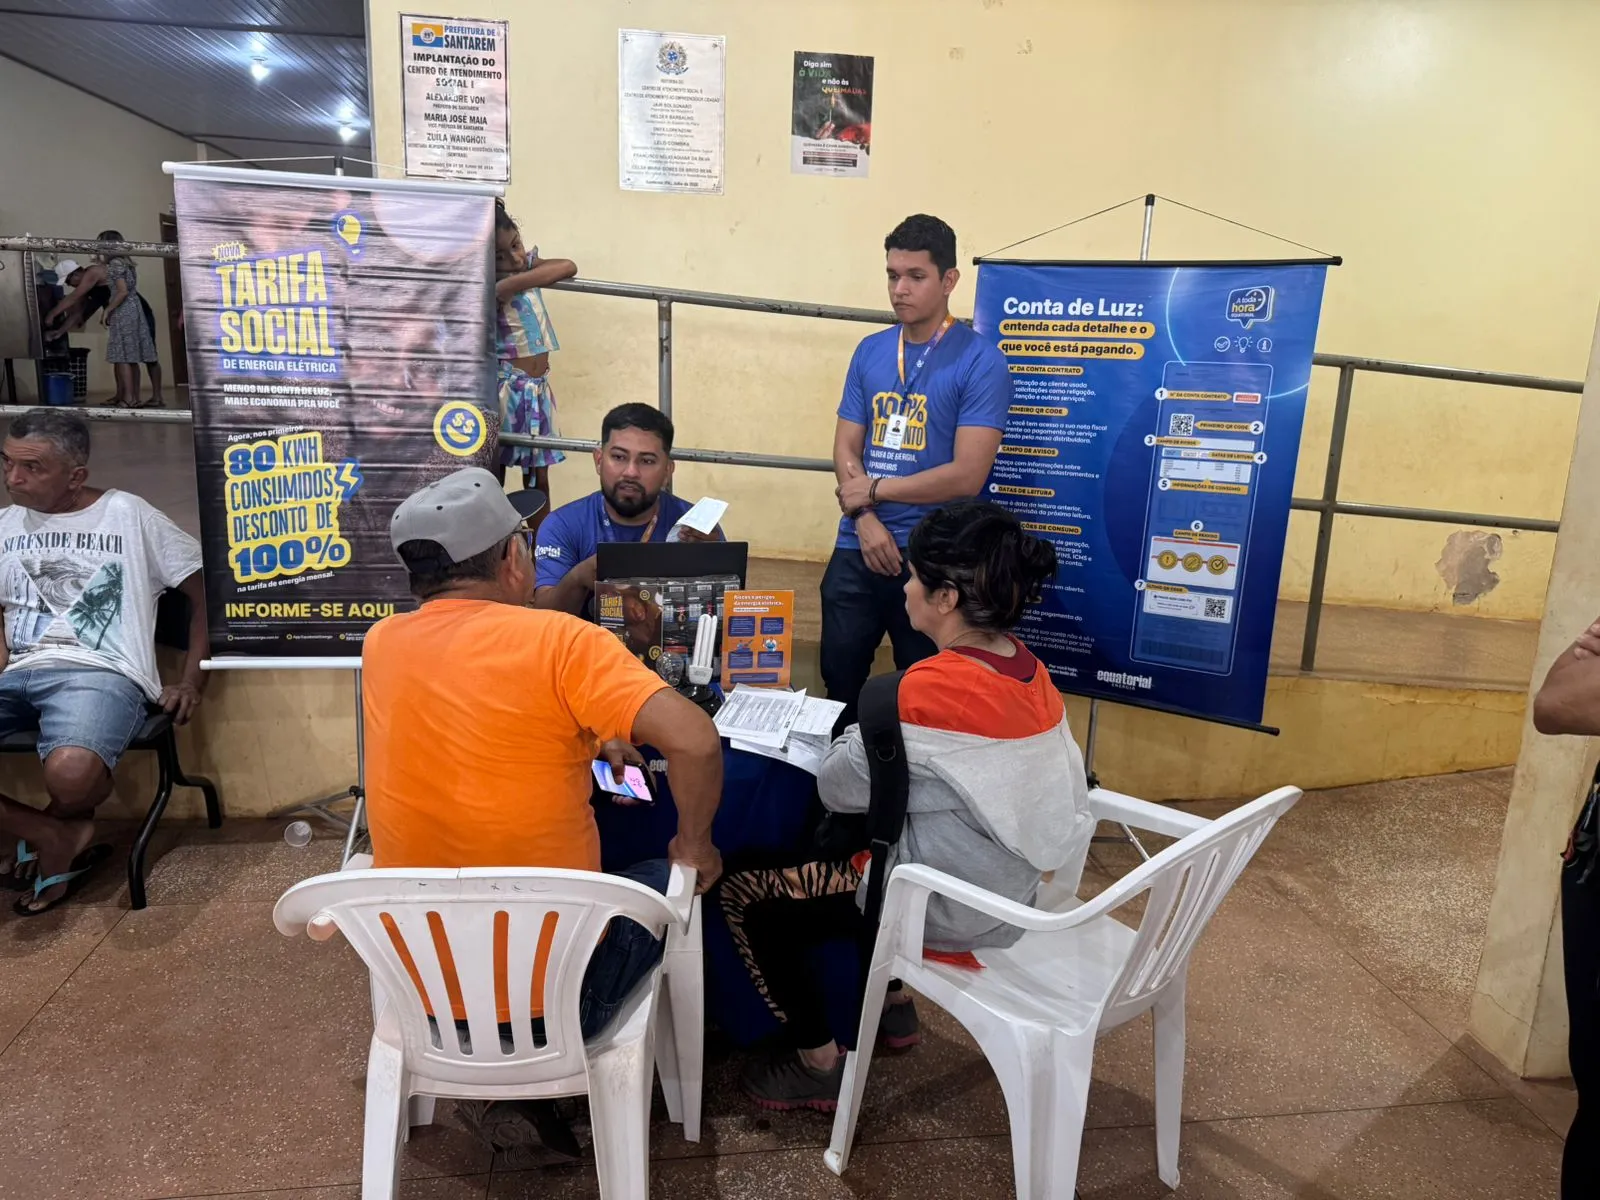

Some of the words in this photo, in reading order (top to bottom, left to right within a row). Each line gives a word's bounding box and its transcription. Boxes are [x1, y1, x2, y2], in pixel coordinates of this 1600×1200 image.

[444, 25, 484, 35] PREFEITURA
[413, 52, 479, 67] IMPLANTAÇÃO
[482, 58, 495, 67] DO
[803, 60, 819, 69] Diga
[407, 65, 436, 75] CENTRO
[438, 67, 448, 76] DE
[450, 68, 502, 80] ATENDIMENTO
[808, 68, 832, 78] VIDA
[470, 95, 485, 105] VON
[424, 113, 447, 122] MARIA
[449, 113, 467, 124] JOSÉ
[469, 116, 488, 125] MAIA
[216, 250, 327, 307] TARIFA
[1003, 297, 1063, 315] Conta
[1068, 298, 1094, 316] de
[1098, 298, 1144, 317] Luz:
[1232, 303, 1255, 312] hora
[219, 307, 335, 356] SOCIAL
[1003, 322, 1049, 331] entenda
[1052, 323, 1079, 332] cada
[1082, 323, 1127, 333] detalhe
[1001, 343, 1022, 353] que
[1024, 342, 1051, 352] você
[1054, 343, 1078, 353] está
[1081, 345, 1137, 356] pagando.
[223, 359, 237, 369] DE
[239, 359, 285, 371] ENERGIA
[287, 359, 336, 372] ELÉTRICA
[223, 384, 256, 393] MENOS
[257, 385, 270, 393] NA
[271, 386, 300, 394] CONTA
[300, 387, 312, 395] DE
[225, 397, 249, 406] MAIS
[250, 398, 296, 408] ECONOMIA
[298, 400, 316, 408] PRA
[318, 398, 340, 408] VOCÊ
[228, 432, 252, 442] Agora,
[268, 426, 303, 437] primeiros
[228, 445, 276, 475] 80
[282, 436, 318, 469] KWH
[231, 468, 340, 512] CONSUMIDOS,
[233, 506, 307, 543] DESCONTO
[317, 501, 333, 529] DE
[3, 532, 72, 554] SURFSIDE
[76, 533, 122, 554] BEACH
[235, 534, 345, 577] 100%
[237, 585, 247, 593] na
[247, 580, 267, 591] tarifa
[268, 579, 277, 589] de
[279, 575, 306, 588] energia
[306, 571, 335, 583] mensal.
[601, 596, 623, 607] TARIFA
[226, 603, 343, 618] INFORME-SE
[348, 603, 394, 618] AQUI
[601, 607, 624, 617] SOCIAL
[1097, 670, 1152, 689] equatorial
